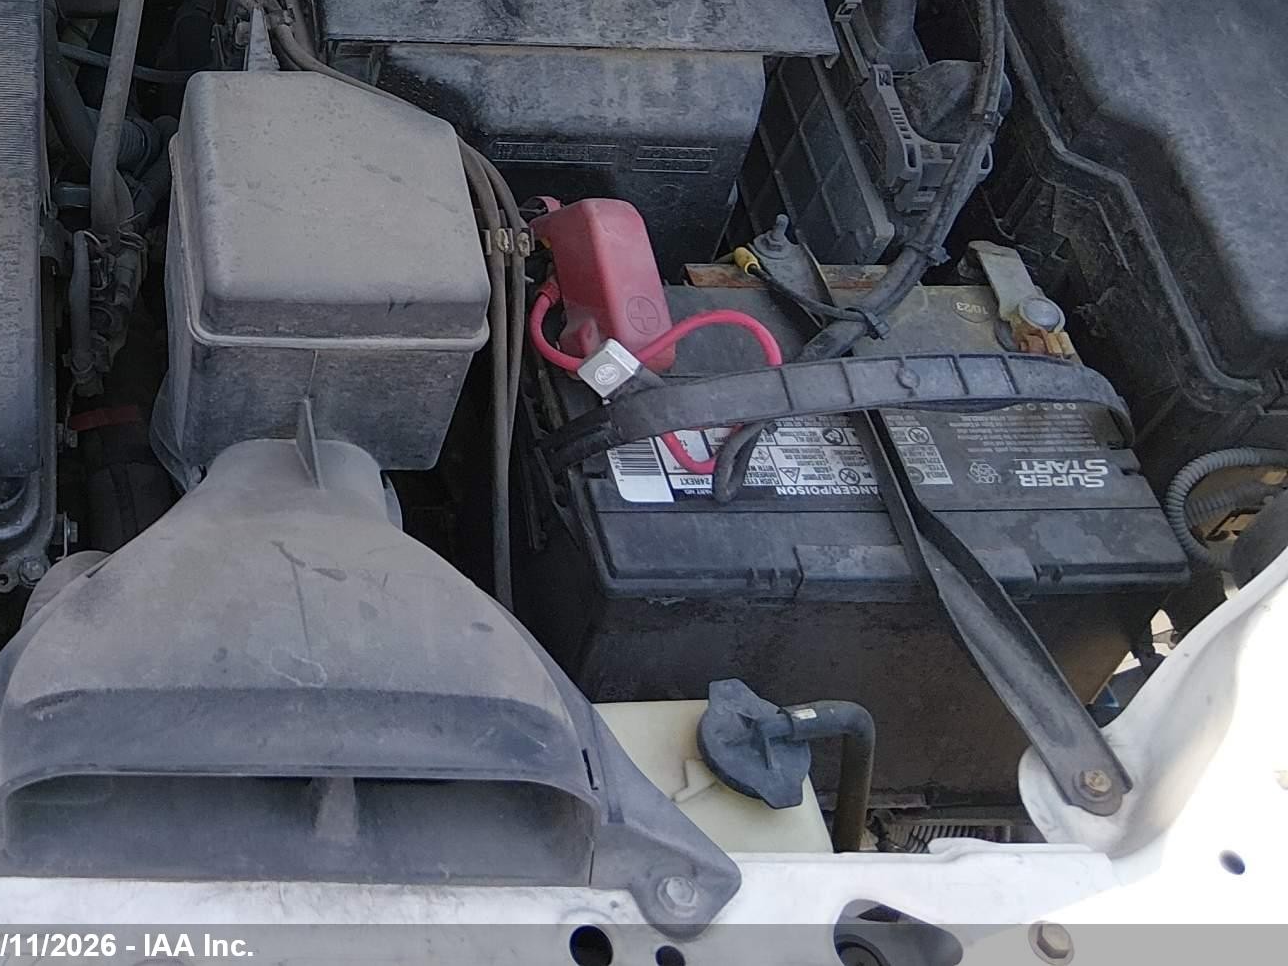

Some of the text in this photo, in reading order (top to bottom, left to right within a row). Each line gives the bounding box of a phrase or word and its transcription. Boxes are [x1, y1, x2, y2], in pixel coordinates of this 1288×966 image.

[1016, 460, 1108, 474] START
[1020, 474, 1104, 487] SUPER
[775, 485, 879, 496] ANGER/POISON
